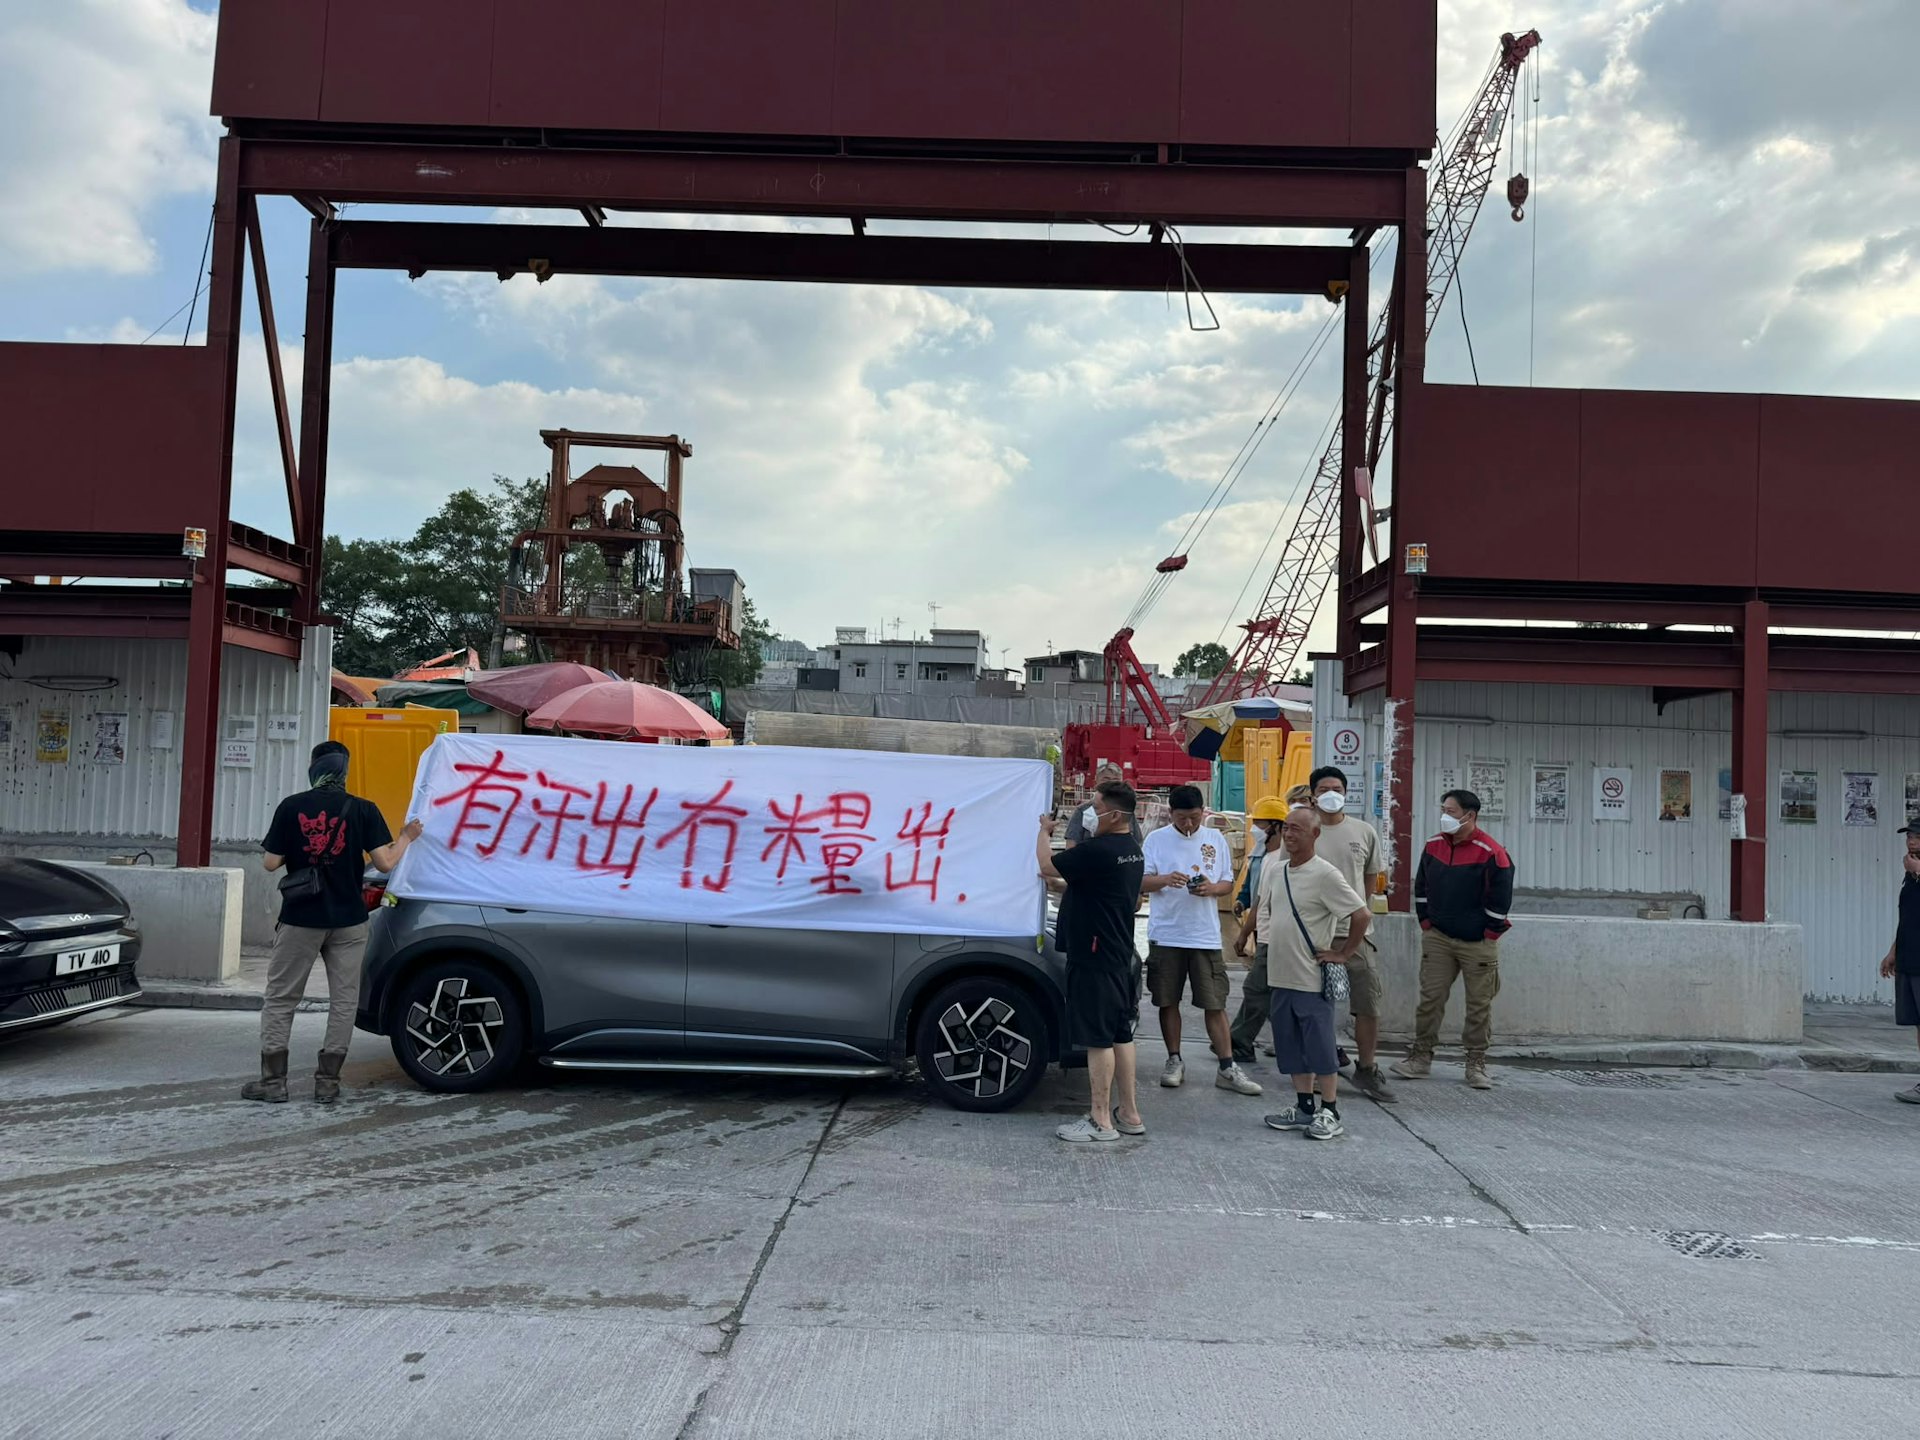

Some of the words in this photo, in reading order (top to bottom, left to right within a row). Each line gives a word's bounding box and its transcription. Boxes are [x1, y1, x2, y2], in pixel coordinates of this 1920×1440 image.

[1344, 733, 1350, 743] 8
[227, 744, 248, 752] CCTV
[68, 952, 86, 970] TV
[91, 948, 111, 966] 410
